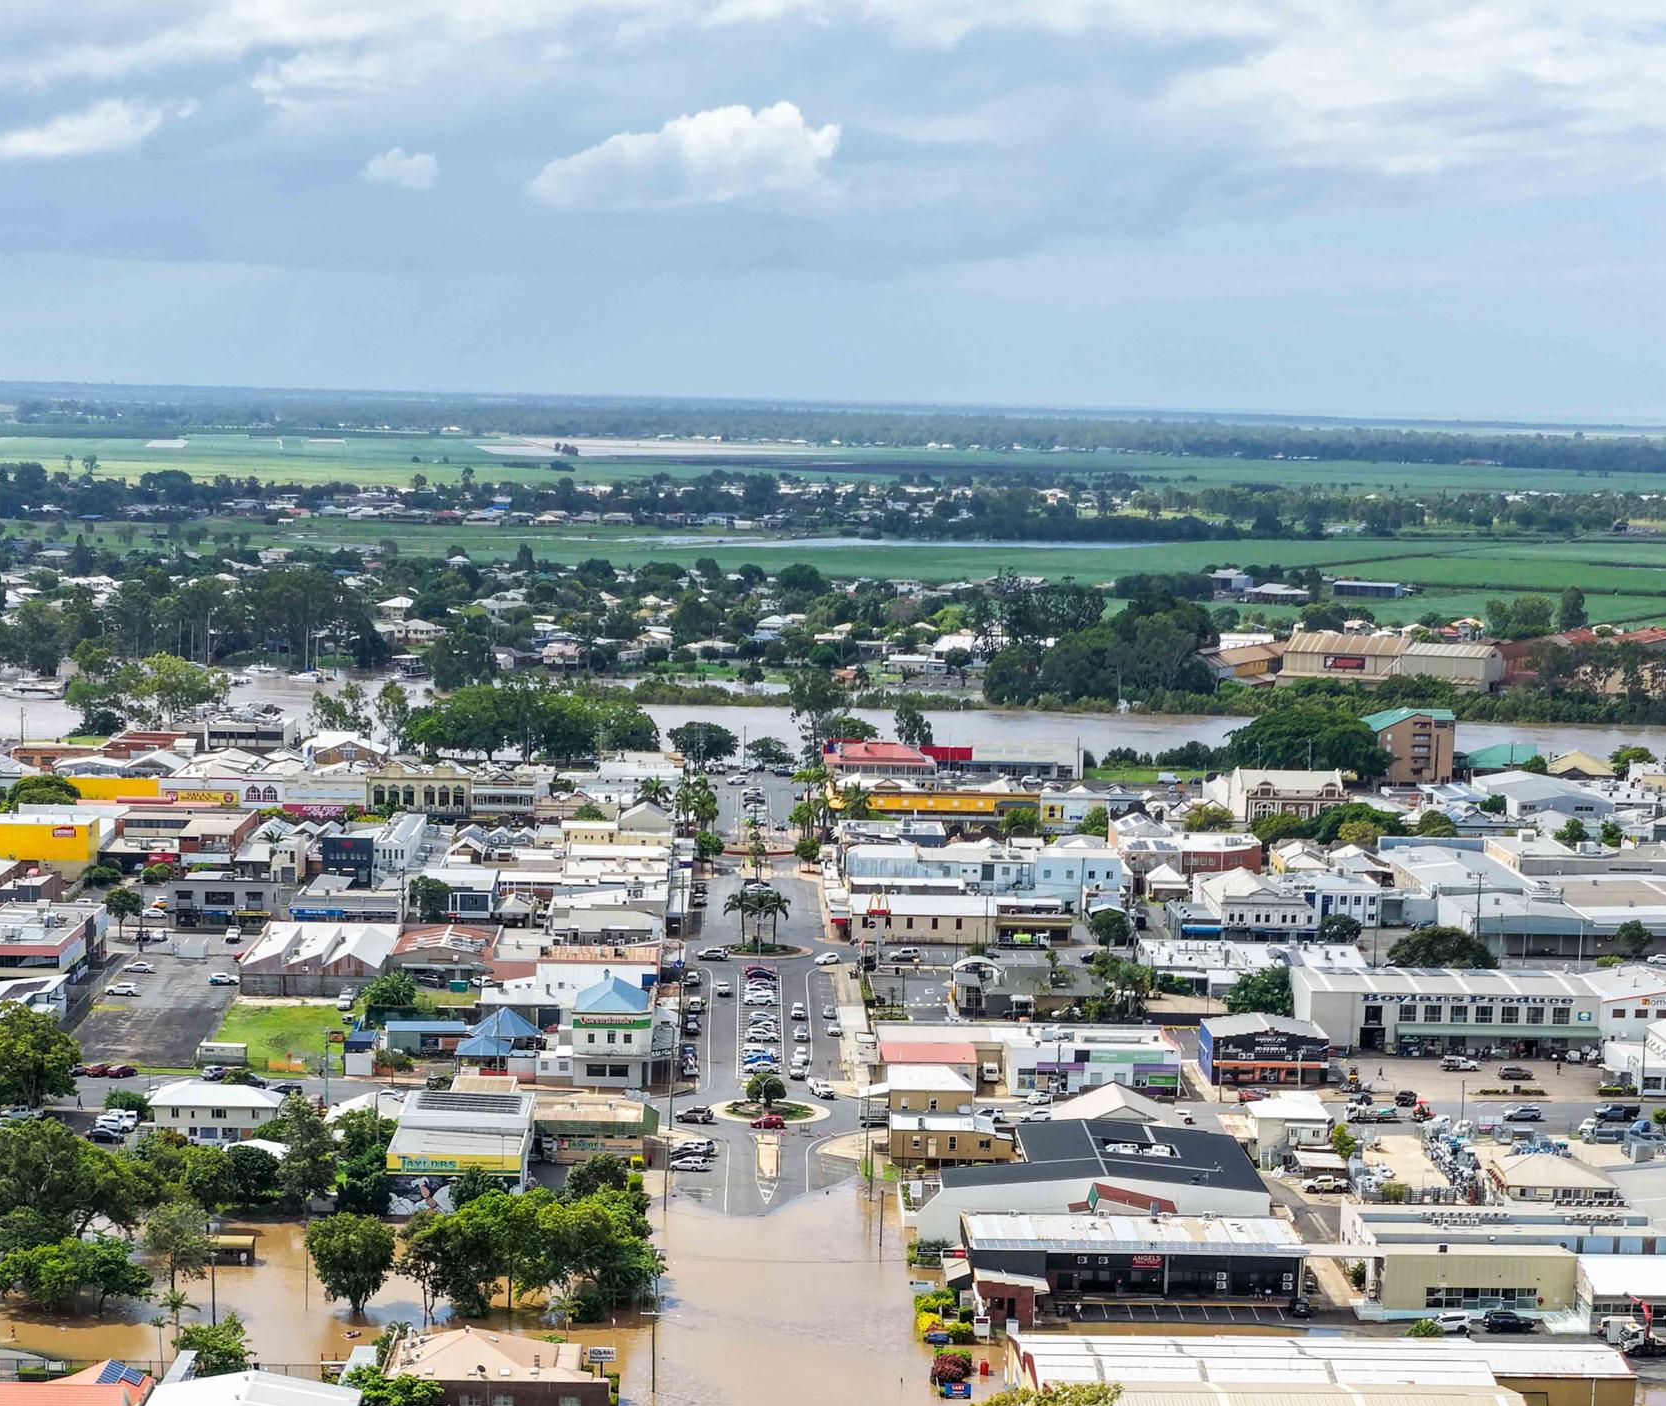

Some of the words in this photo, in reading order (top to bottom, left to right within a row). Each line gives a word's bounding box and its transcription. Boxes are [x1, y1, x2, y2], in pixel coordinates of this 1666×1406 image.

[1469, 994, 1574, 1005] Produce
[580, 1016, 635, 1025] Queenslander
[399, 1156, 457, 1171] TAYLORS
